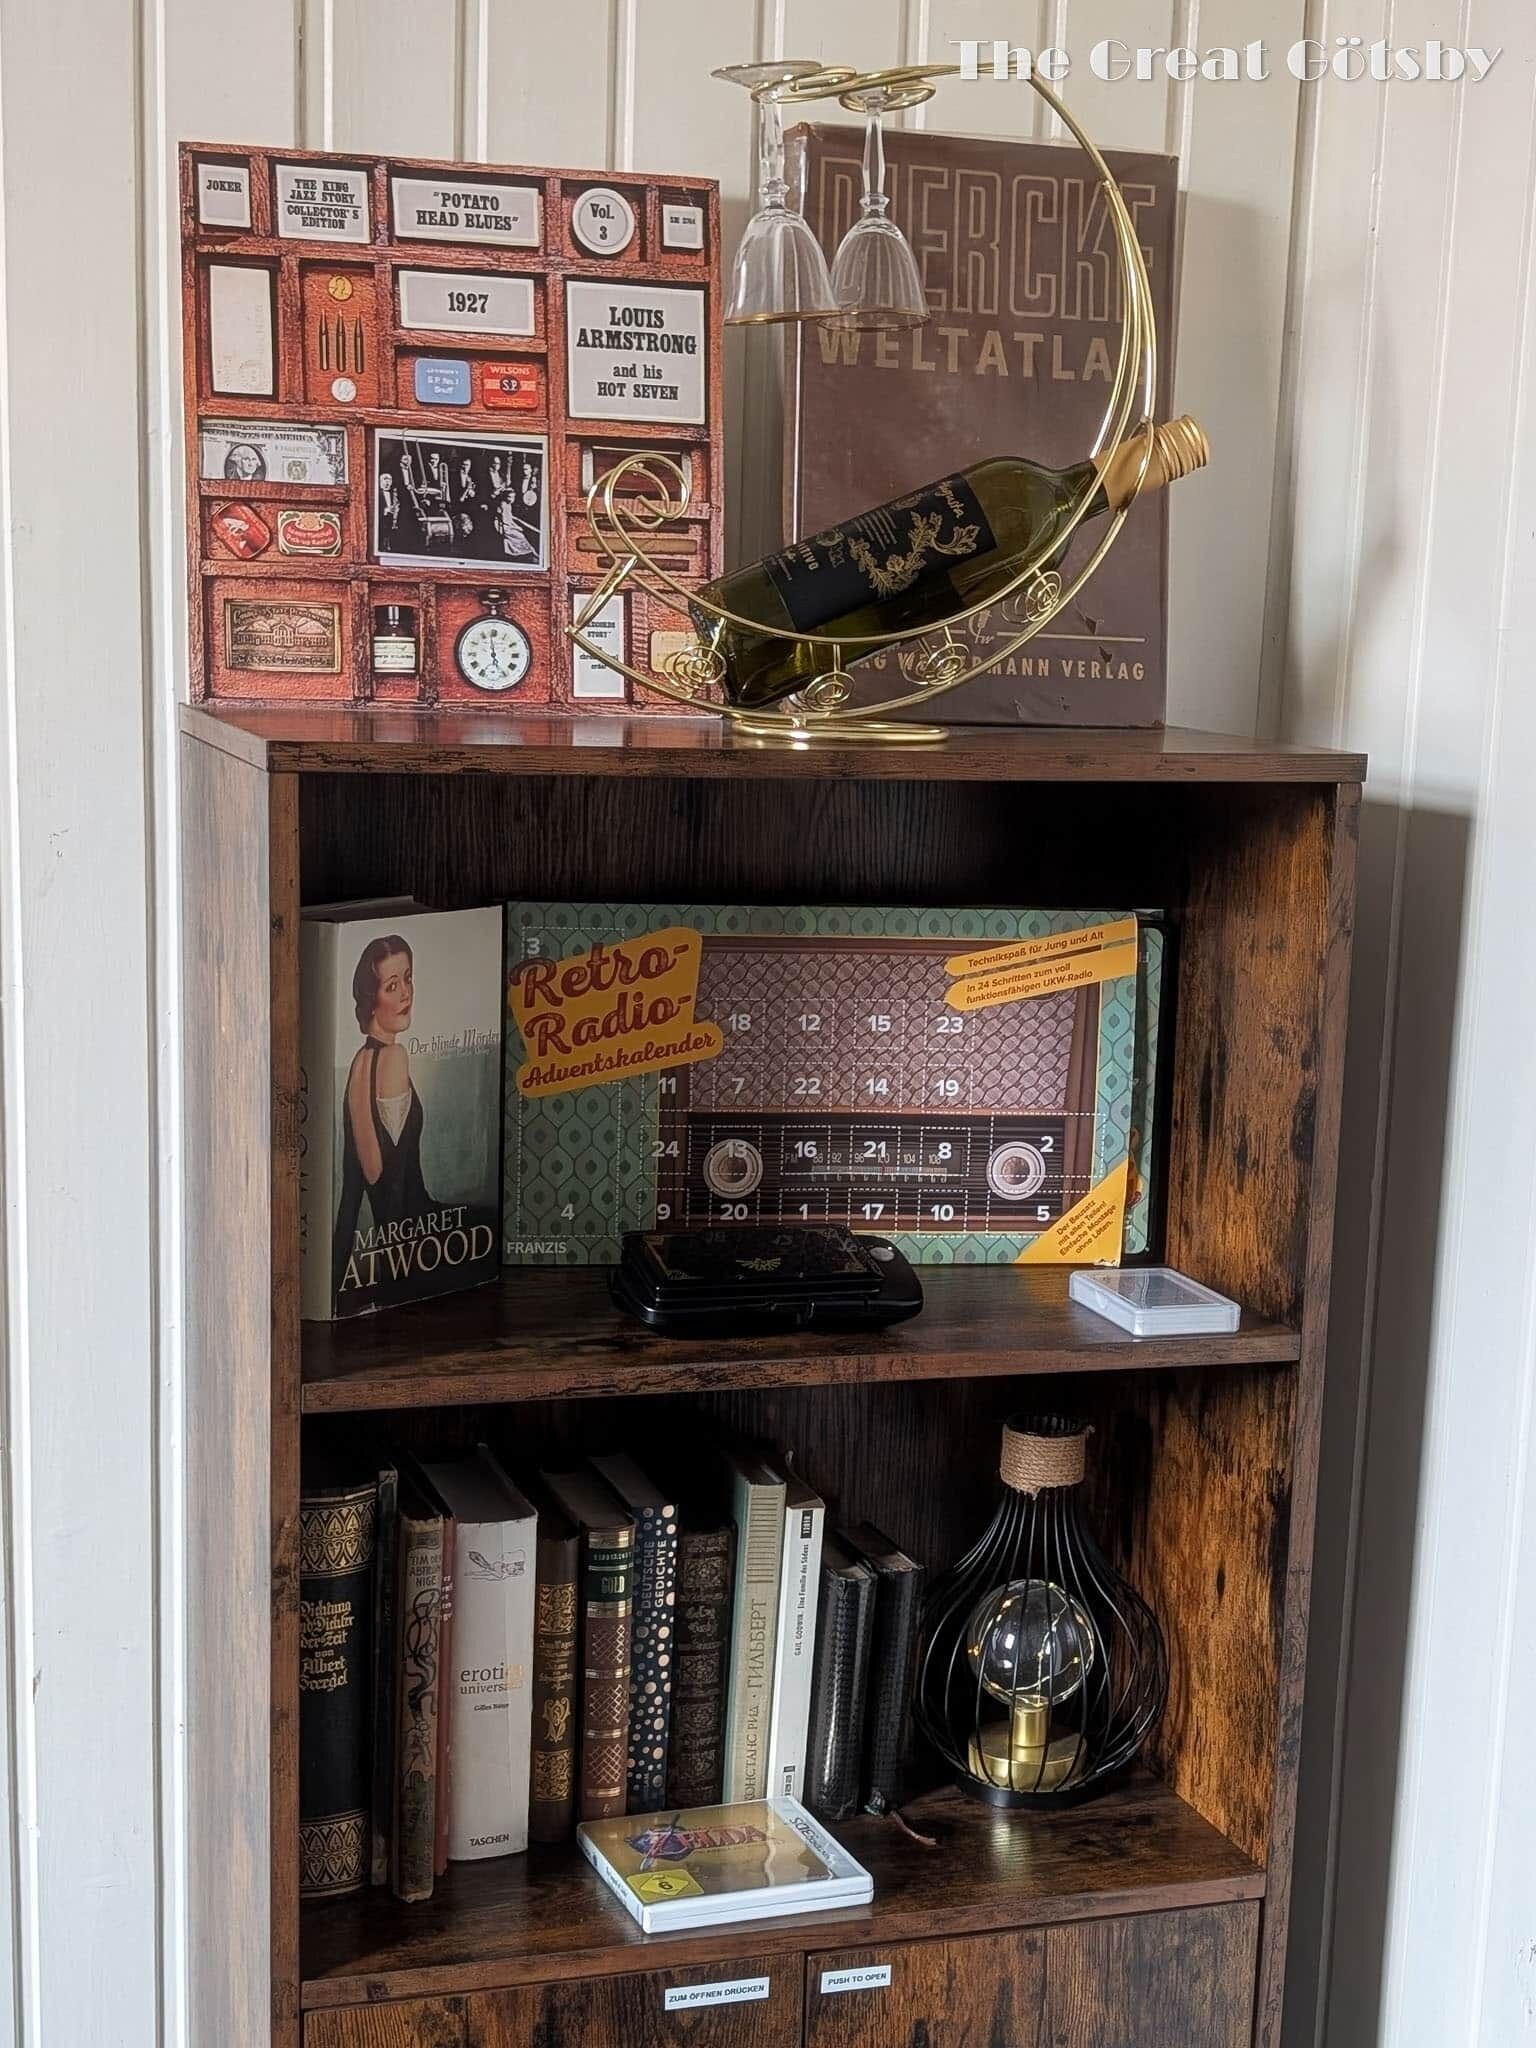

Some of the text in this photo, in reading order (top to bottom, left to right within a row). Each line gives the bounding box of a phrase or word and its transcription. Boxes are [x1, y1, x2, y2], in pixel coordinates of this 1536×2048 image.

[206, 179, 242, 193] JOKER
[294, 178, 349, 193] THE KING
[289, 189, 355, 204] JAZZ STORY
[416, 209, 459, 228] HEAD
[590, 202, 615, 219] Vol.
[301, 216, 345, 229] EDITION
[599, 226, 608, 240] 3
[447, 291, 489, 314] 1927
[608, 306, 665, 329] LOUIS
[576, 328, 697, 355] ARMSTRONG
[816, 317, 1148, 385] WELTATLA
[612, 363, 663, 380] and his
[597, 381, 679, 401] HOT SEVEN
[1061, 659, 1146, 681] VERLAG
[526, 937, 540, 955] 3
[968, 930, 1104, 968] Technikspaß für Jung und Alt
[509, 942, 689, 1008] Retro-
[966, 963, 1071, 993] In 24 Schritten zum voll
[966, 970, 1093, 1005] funktionsfähigen UKW-Radio
[524, 991, 692, 1057] Radio-
[728, 1013, 964, 1034] 18 12 15 23
[521, 1032, 717, 1089] Adventskalender
[657, 1077, 960, 1097] 11 7 22 14 19
[651, 1136, 1055, 1159] 24 13 16 21 8 2
[831, 1153, 842, 1164] 92
[903, 1153, 916, 1164] 104
[561, 1203, 575, 1221] 4
[657, 1203, 1051, 1221] 9 20 1 17 10 5
[353, 1206, 467, 1252] MARGARET
[506, 1241, 568, 1255] FRANZIS
[338, 1224, 493, 1293] ATWOOD
[641, 1540, 655, 1609] DEUTSCHE
[654, 1540, 667, 1608] GEDICHTE
[748, 1599, 767, 1689] ГИЛЬБЕРТ
[460, 1682, 523, 1695] univers
[748, 1705, 760, 1730] РИД
[469, 1833, 510, 1847] TASCHEN
[828, 1972, 887, 1986] PUSH TO OPEN
[669, 1984, 765, 2003] ZUM ÖFFNEN DRÜCKEN
